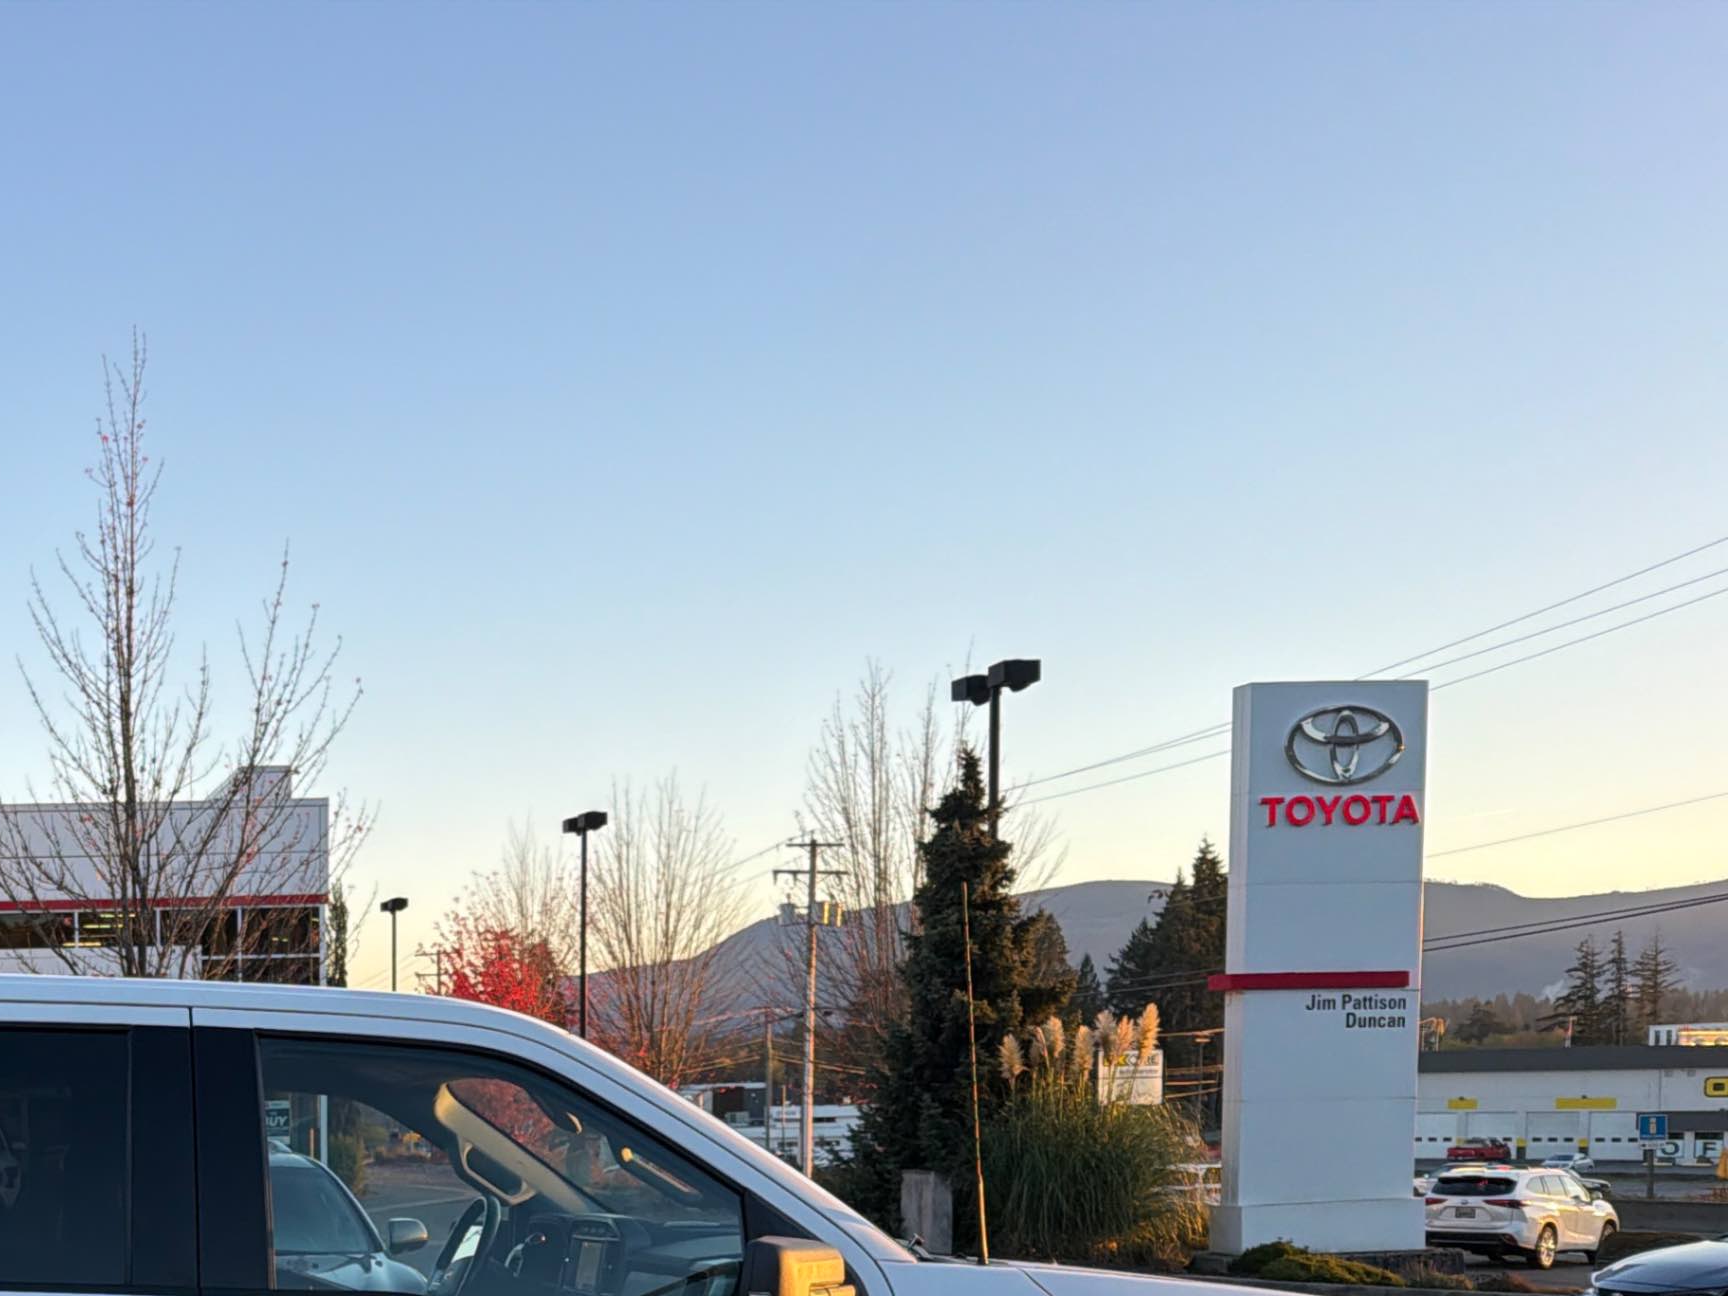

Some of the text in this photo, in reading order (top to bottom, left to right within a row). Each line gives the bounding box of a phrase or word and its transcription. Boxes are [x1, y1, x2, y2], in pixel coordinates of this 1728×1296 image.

[1259, 794, 1420, 828] TOYOTA
[1305, 993, 1407, 1011] Jim Pattison
[1345, 1012, 1406, 1028] Duncan
